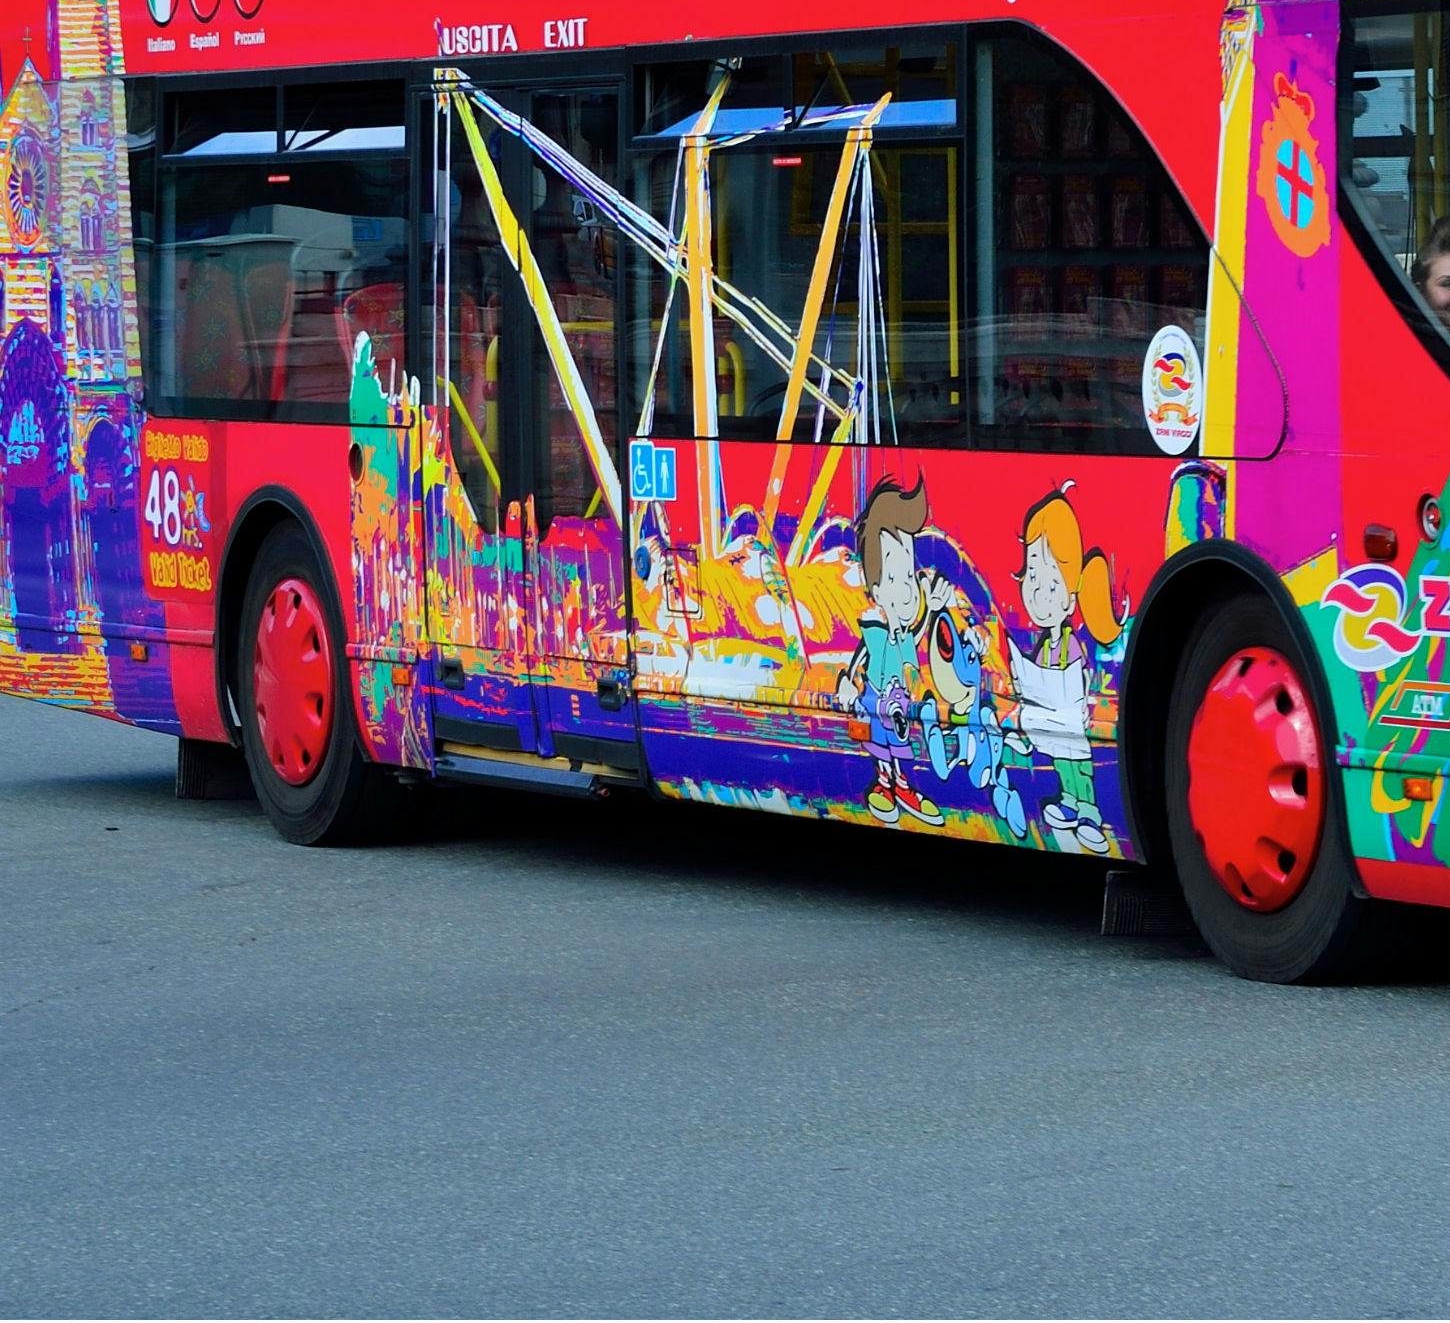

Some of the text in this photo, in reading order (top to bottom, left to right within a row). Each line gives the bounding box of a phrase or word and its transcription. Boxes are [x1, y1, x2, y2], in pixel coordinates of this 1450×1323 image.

[147, 37, 176, 53] Italiano
[189, 31, 220, 52] Español
[443, 17, 589, 55] USCITA EXIT
[145, 469, 182, 545] 48
[150, 551, 212, 592] Valid Ticket
